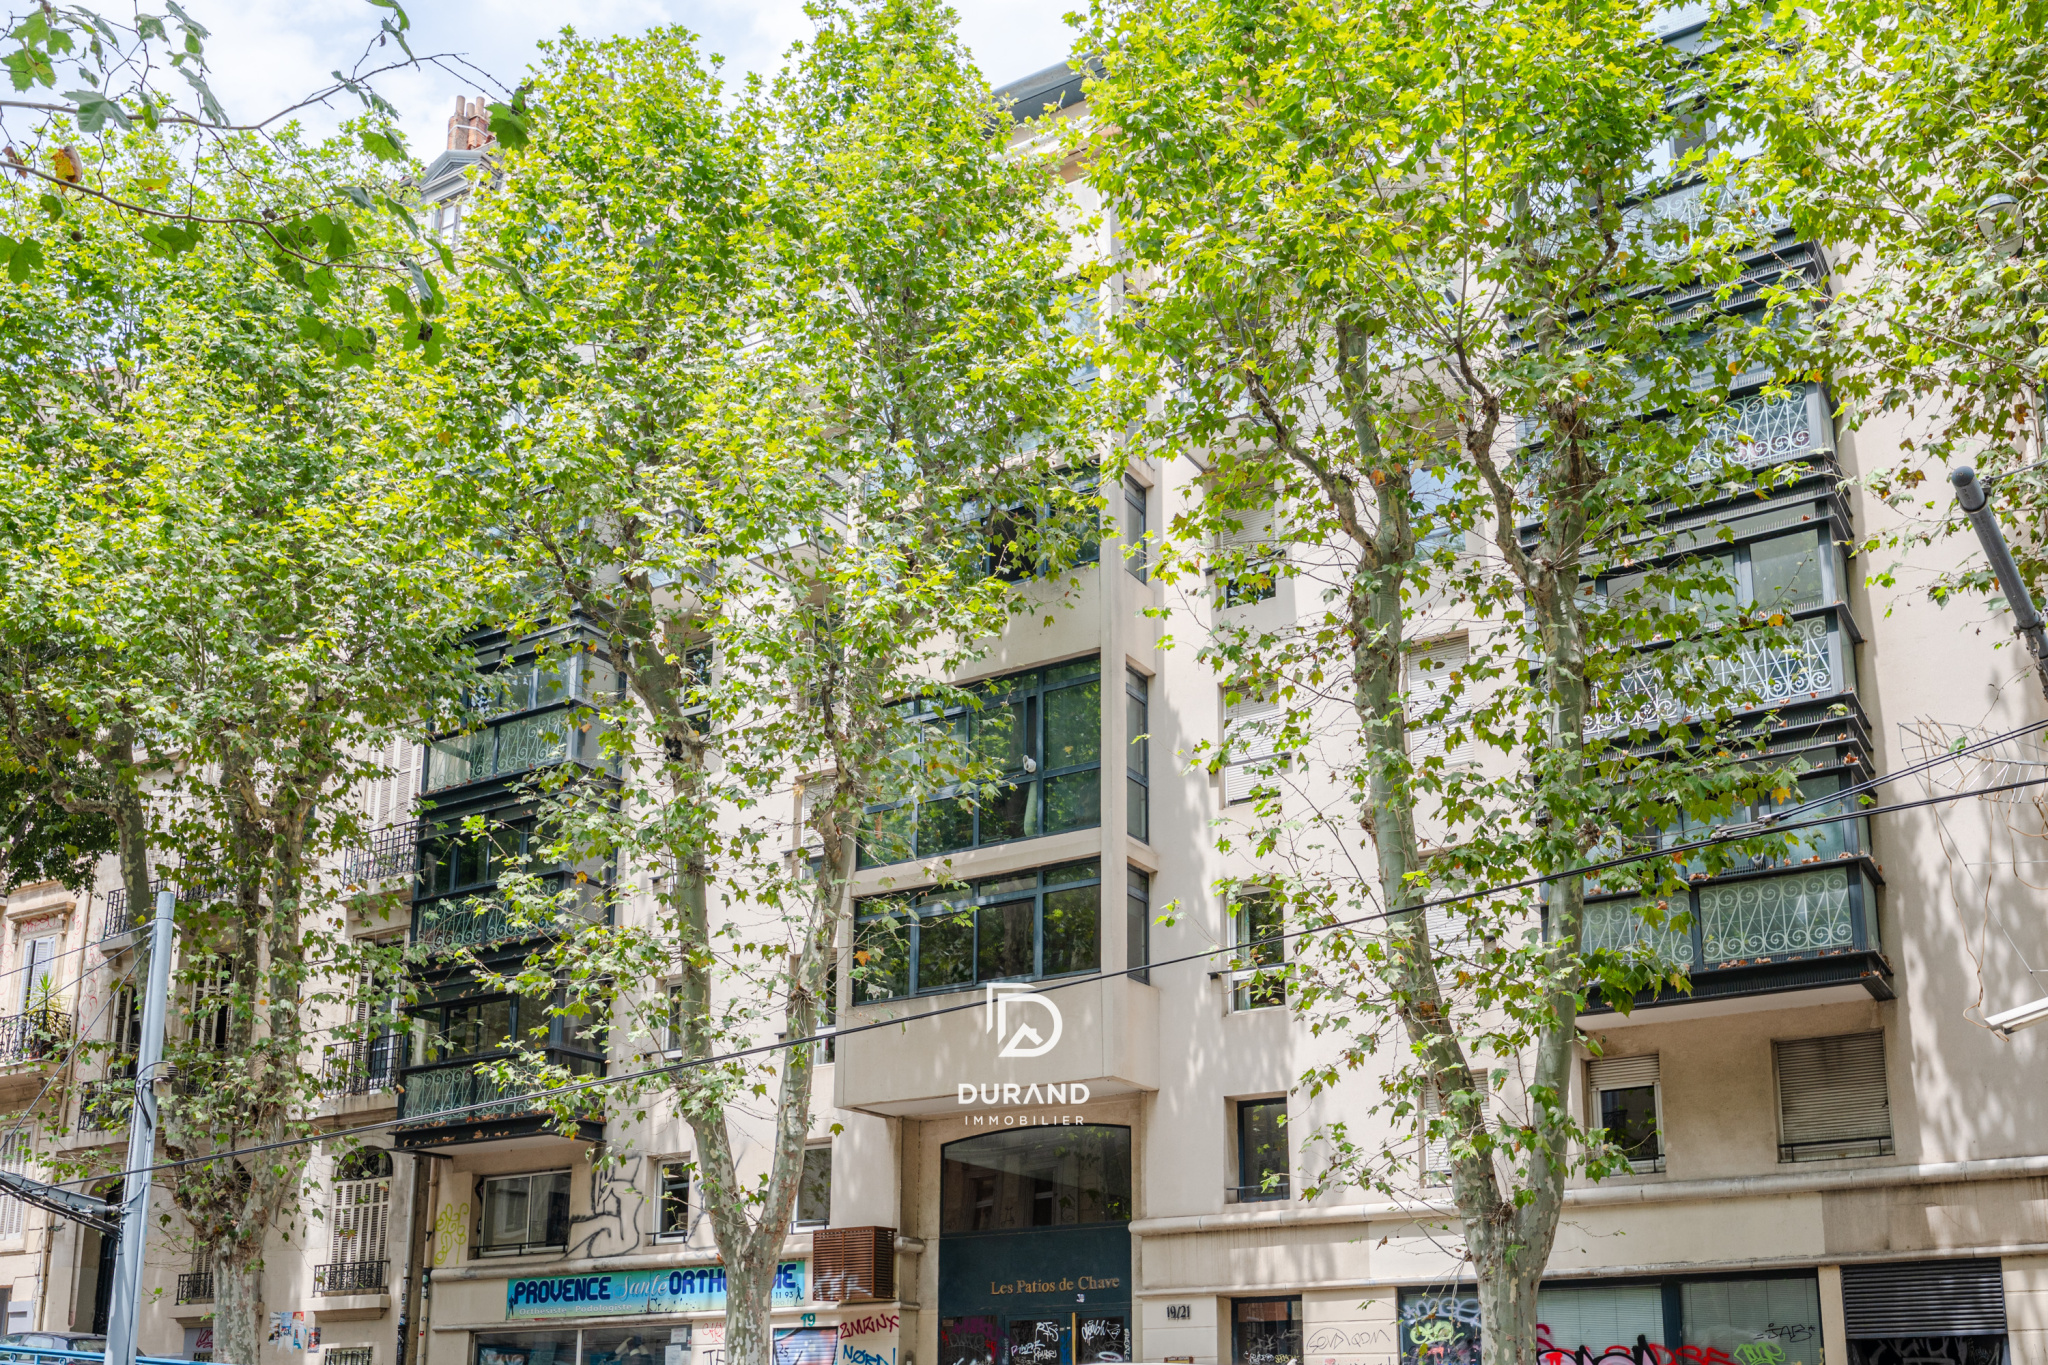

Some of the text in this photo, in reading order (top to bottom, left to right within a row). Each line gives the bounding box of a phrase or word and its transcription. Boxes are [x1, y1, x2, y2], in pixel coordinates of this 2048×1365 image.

[514, 1276, 611, 1304] PROVENCE
[614, 1273, 669, 1302] Santé
[991, 1275, 1120, 1295] Les Patios de Chave
[519, 1303, 633, 1316] Orthésiste Podologiste
[1166, 1305, 1191, 1319] 19/21
[800, 1312, 816, 1327] 19
